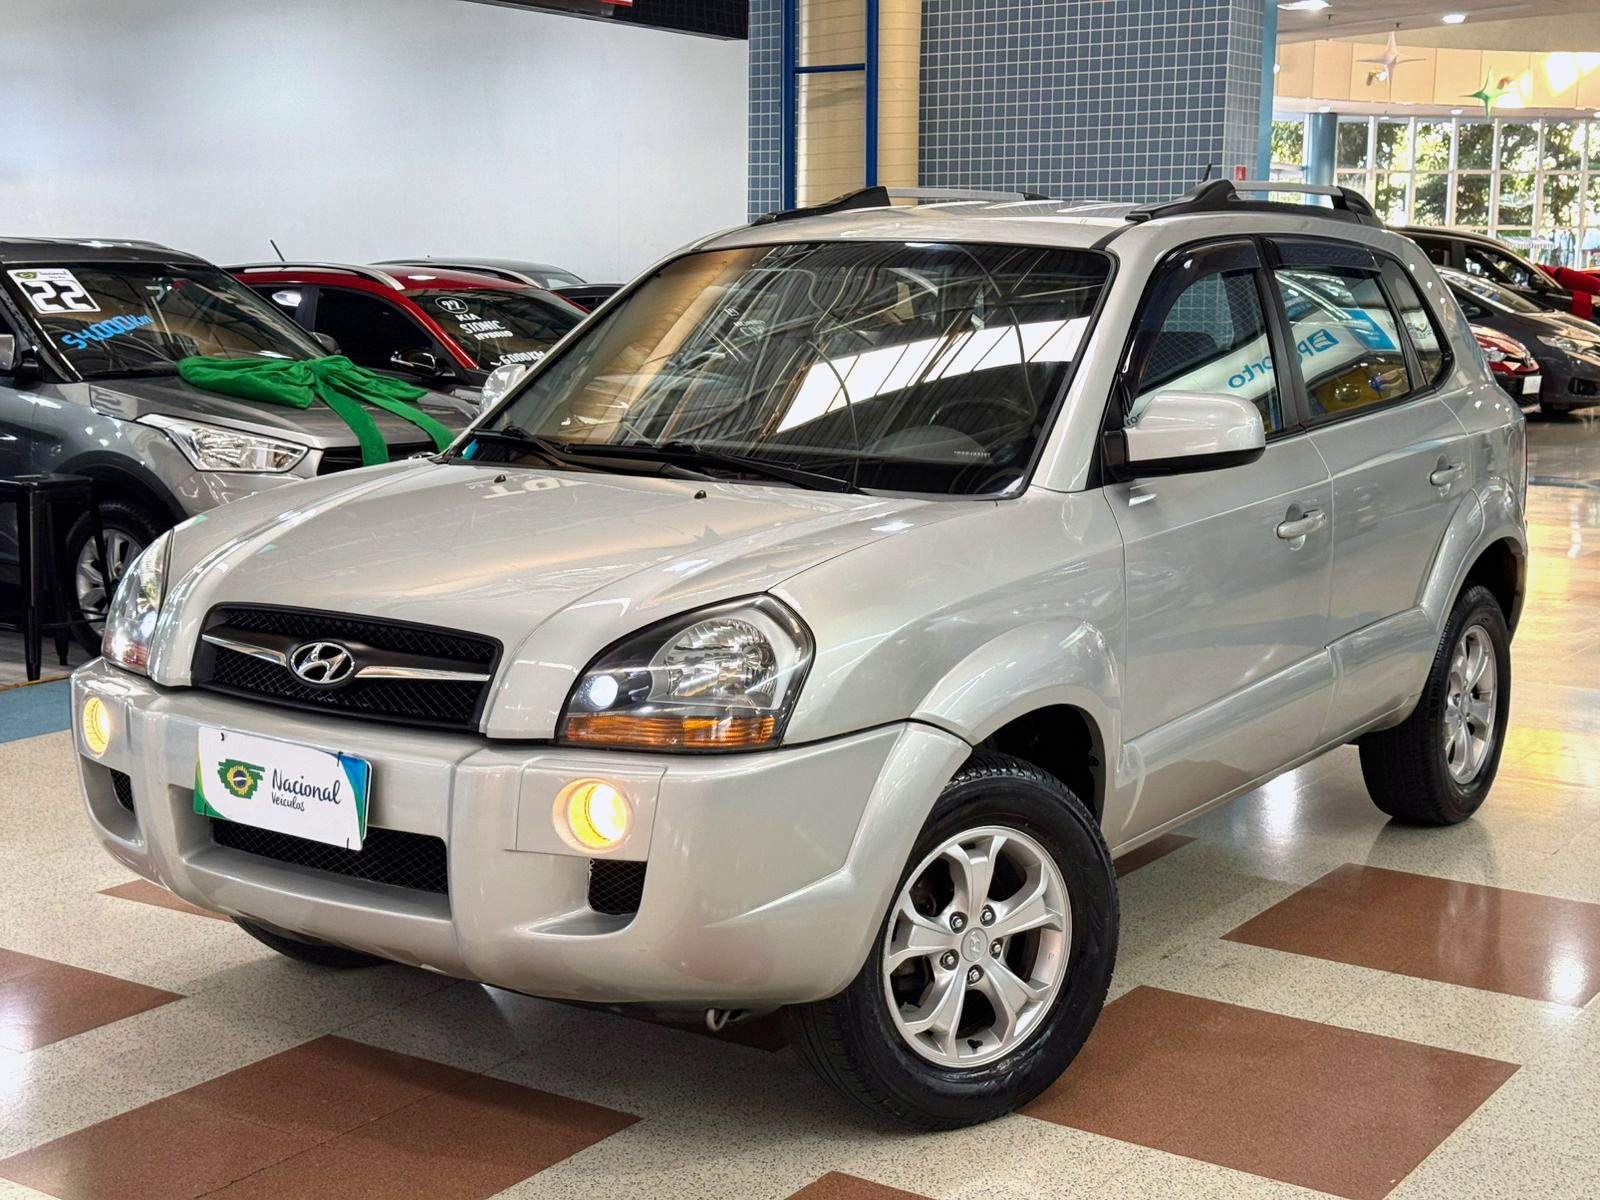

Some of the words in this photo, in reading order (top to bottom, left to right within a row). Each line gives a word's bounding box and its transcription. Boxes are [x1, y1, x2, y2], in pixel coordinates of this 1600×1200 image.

[22, 280, 94, 310] 22
[440, 299, 466, 311] 22
[454, 313, 482, 322] KIA
[459, 320, 506, 334] STONIC
[474, 330, 514, 340] HYBRID
[271, 767, 343, 805] Nacional
